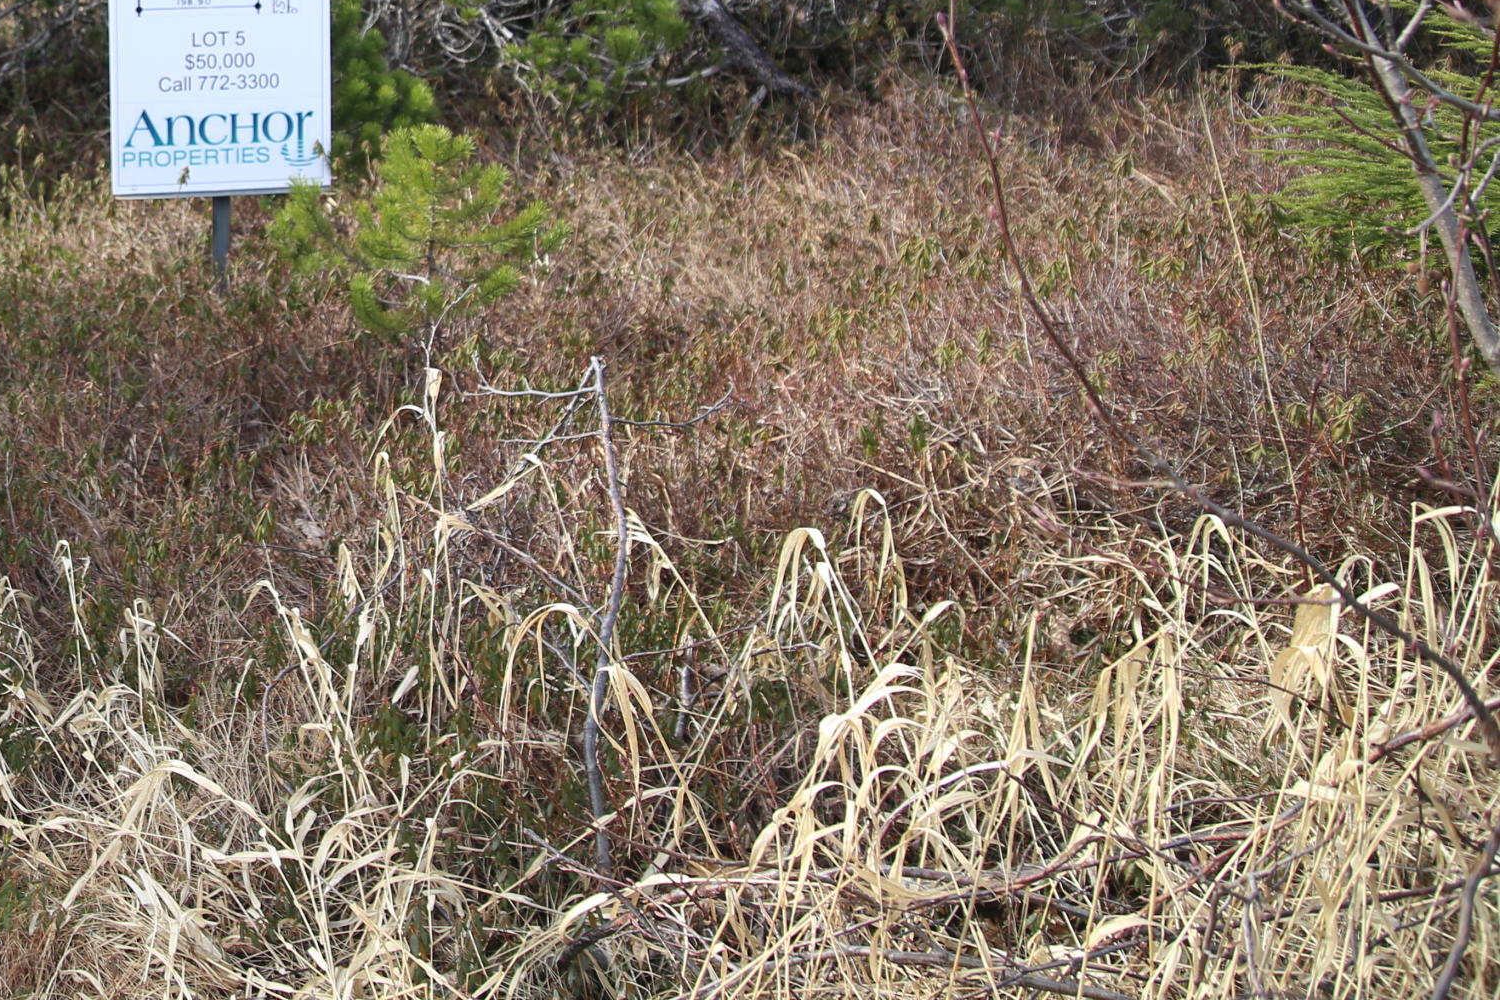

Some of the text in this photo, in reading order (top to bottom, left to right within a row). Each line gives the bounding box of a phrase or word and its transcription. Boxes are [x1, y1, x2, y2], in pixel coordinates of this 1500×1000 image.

[191, 31, 246, 48] LOT 5
[184, 52, 256, 71] $50,000
[158, 73, 280, 93] Call 772-3300
[122, 147, 271, 168] PROPERTIES
